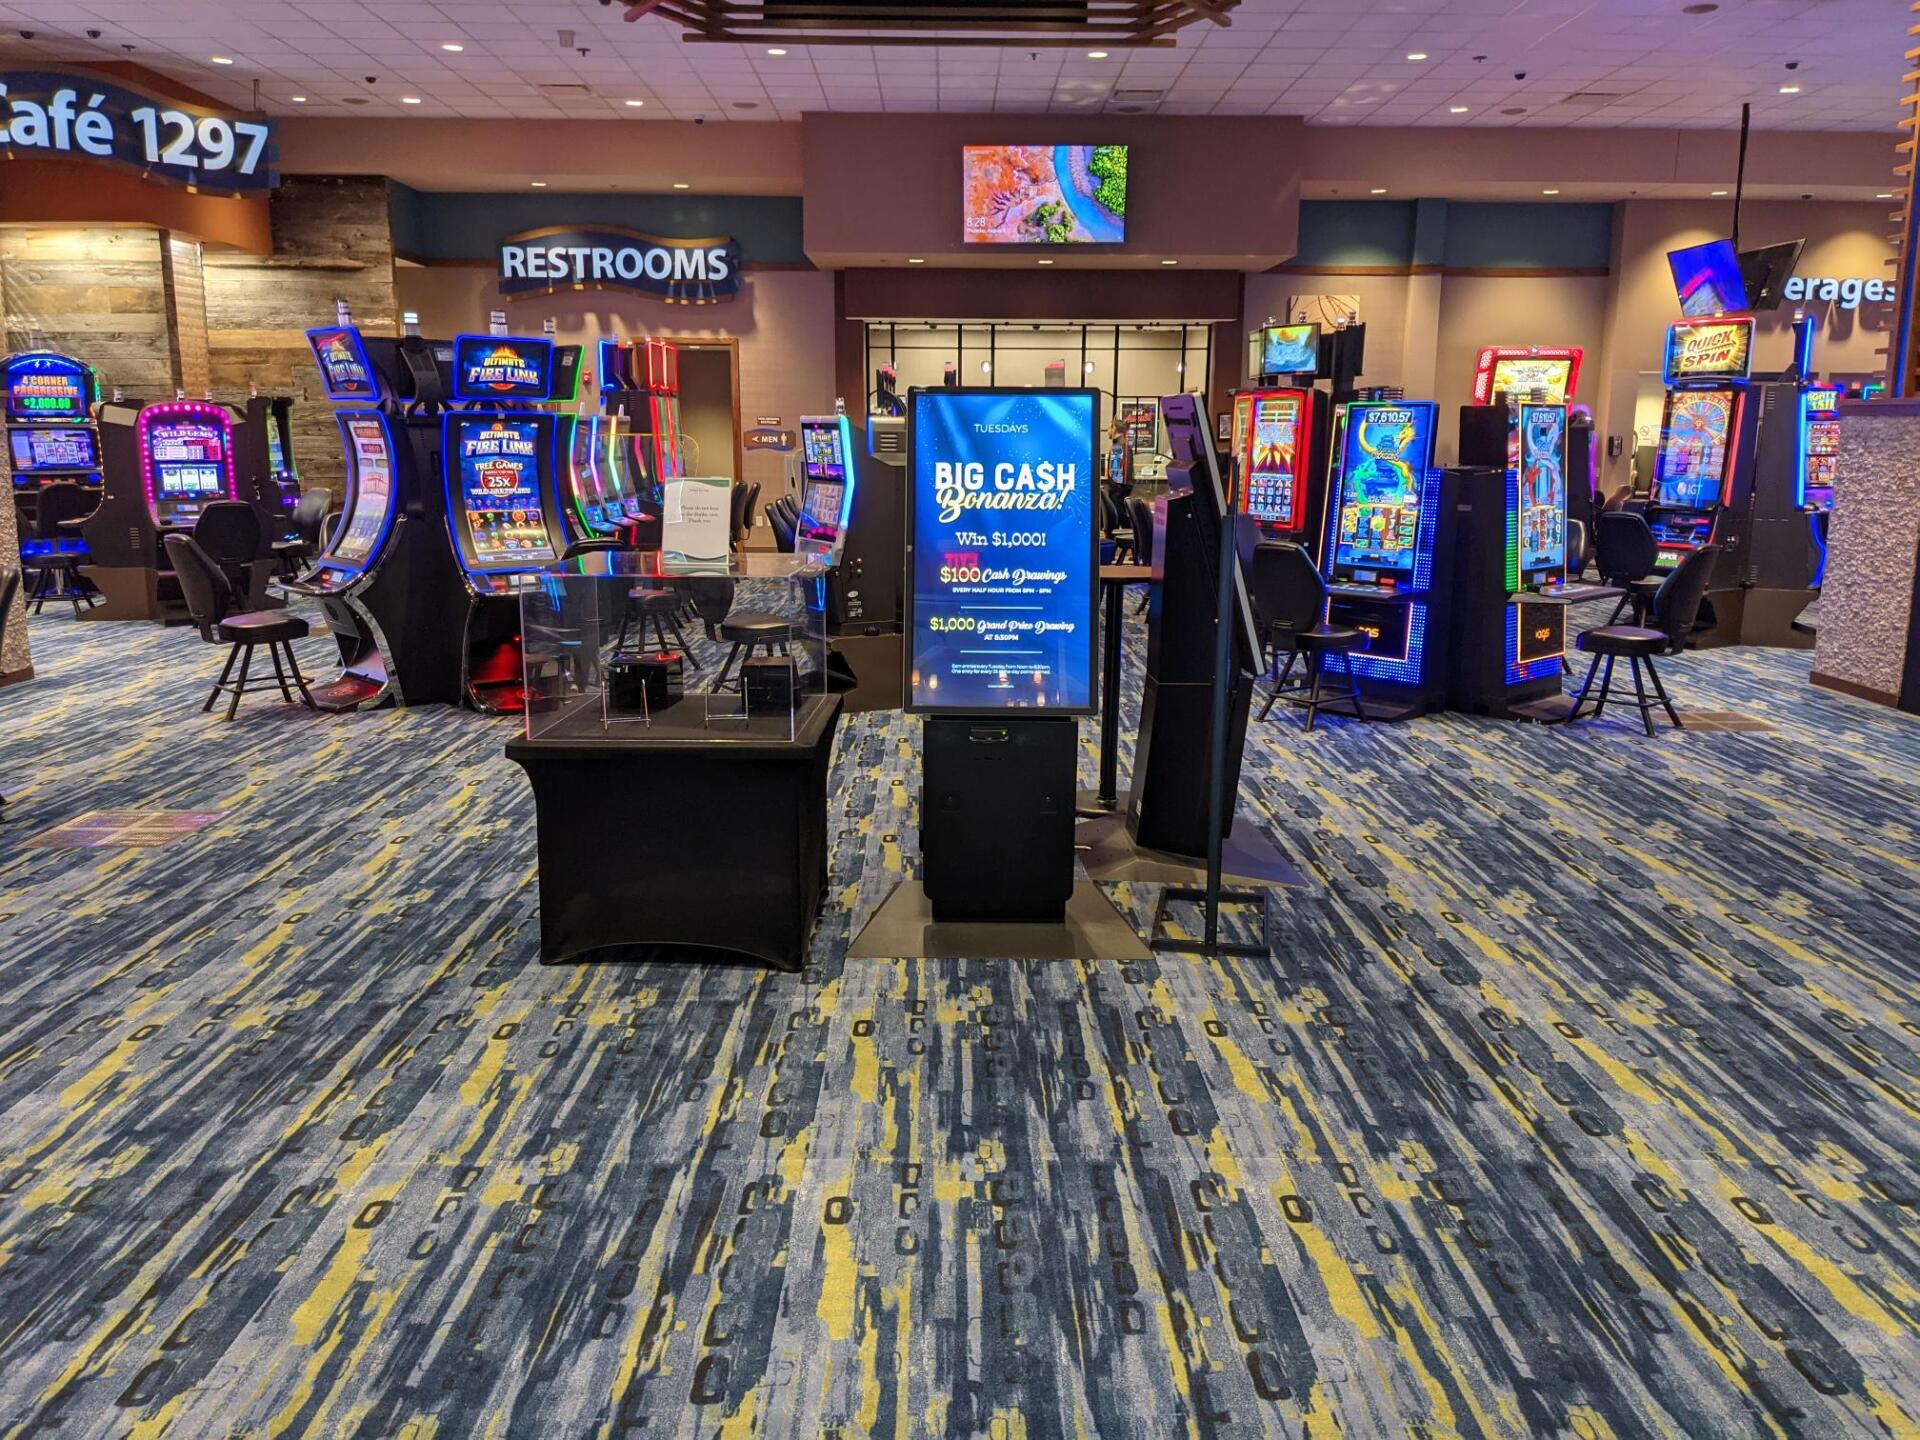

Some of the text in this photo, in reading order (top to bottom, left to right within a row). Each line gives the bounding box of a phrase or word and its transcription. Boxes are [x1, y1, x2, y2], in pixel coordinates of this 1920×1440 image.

[0, 82, 269, 175] afé 1297
[502, 246, 729, 280] RESTROOMS
[1687, 330, 1733, 352] QUICK
[483, 357, 525, 368] ULTIMATE
[1684, 350, 1730, 367] SPIN
[22, 375, 68, 386] 4 CORNER
[468, 368, 539, 384] FIRE LINK
[13, 385, 78, 395] PROGRESSIVE
[24, 397, 71, 409] $2,000.00
[1368, 411, 1411, 423] $7,610.57
[480, 431, 520, 440] ULTIMATE
[974, 423, 1029, 433] TUESDAYS
[761, 435, 778, 443] MEN
[465, 439, 534, 456] FIRE LINK
[475, 461, 523, 471] FREE GAMES
[935, 460, 1076, 492] BIG CA$H
[936, 483, 1071, 523] Bonanza!
[955, 531, 1046, 549] Win $1,000!
[940, 565, 1067, 586] $100 Cash Drawings
[930, 617, 1075, 634] $1,000 Grand Prize Drawing
